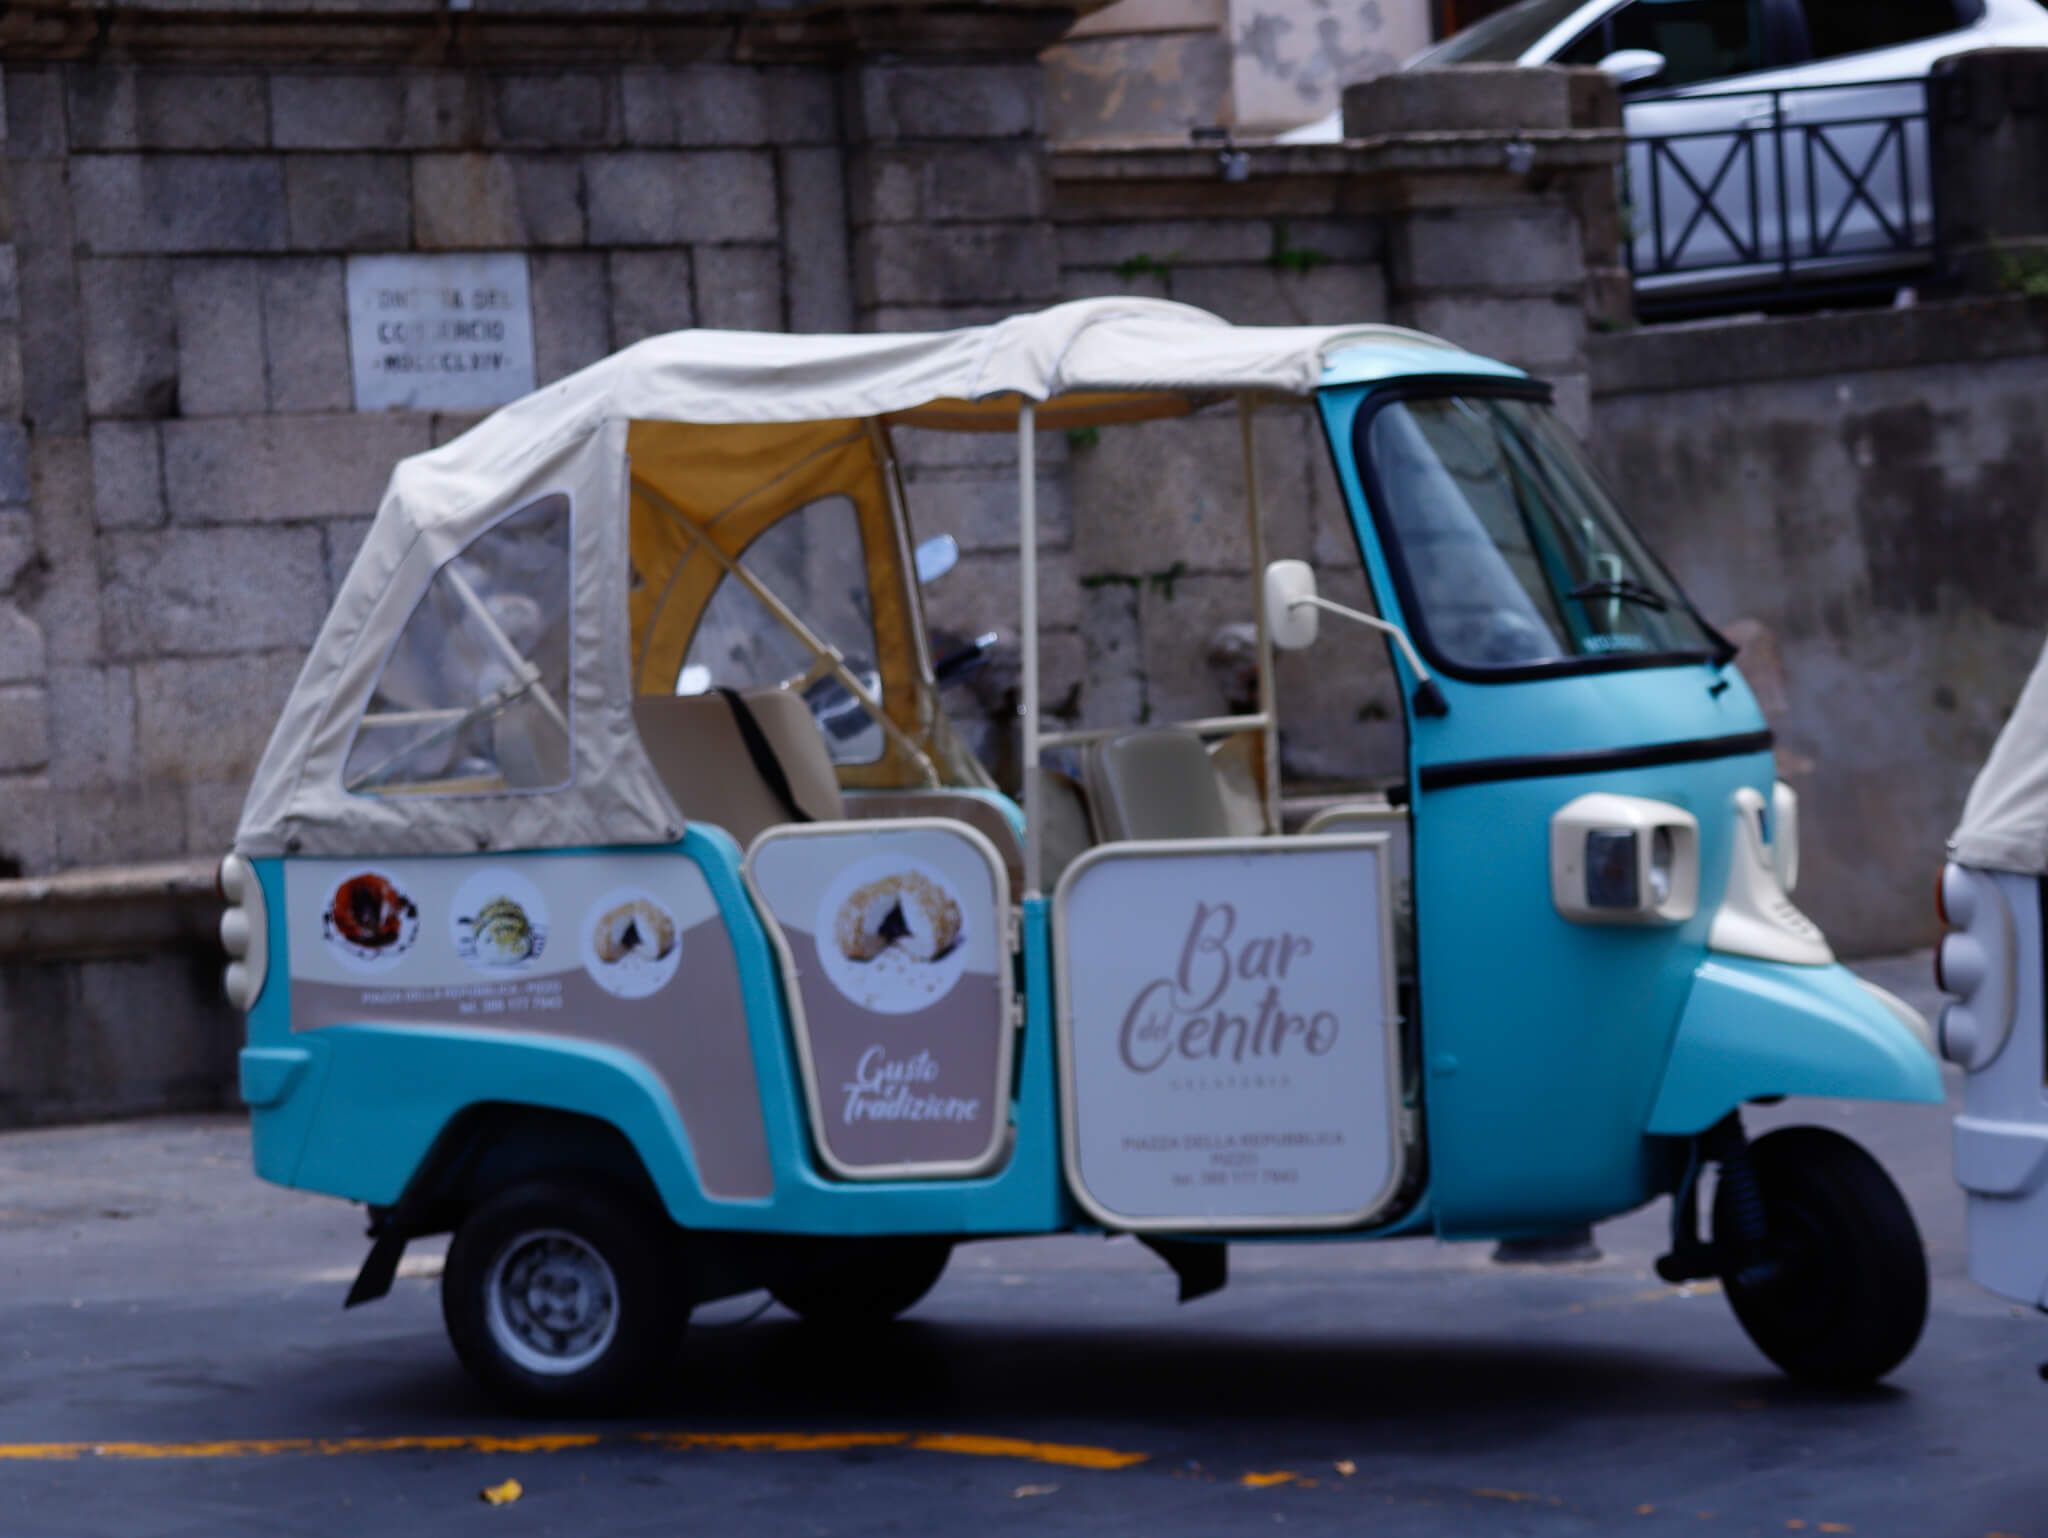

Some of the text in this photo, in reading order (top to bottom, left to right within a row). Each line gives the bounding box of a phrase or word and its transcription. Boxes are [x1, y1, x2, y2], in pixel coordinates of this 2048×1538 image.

[1171, 898, 1316, 1014] Bar
[1117, 976, 1341, 1076] Centro
[1137, 1009, 1174, 1042] del
[855, 1043, 940, 1094] Gusto
[841, 1080, 981, 1126] Tradizione
[1121, 1131, 1346, 1151] PIAZZA DELLA REPUBBLICA
